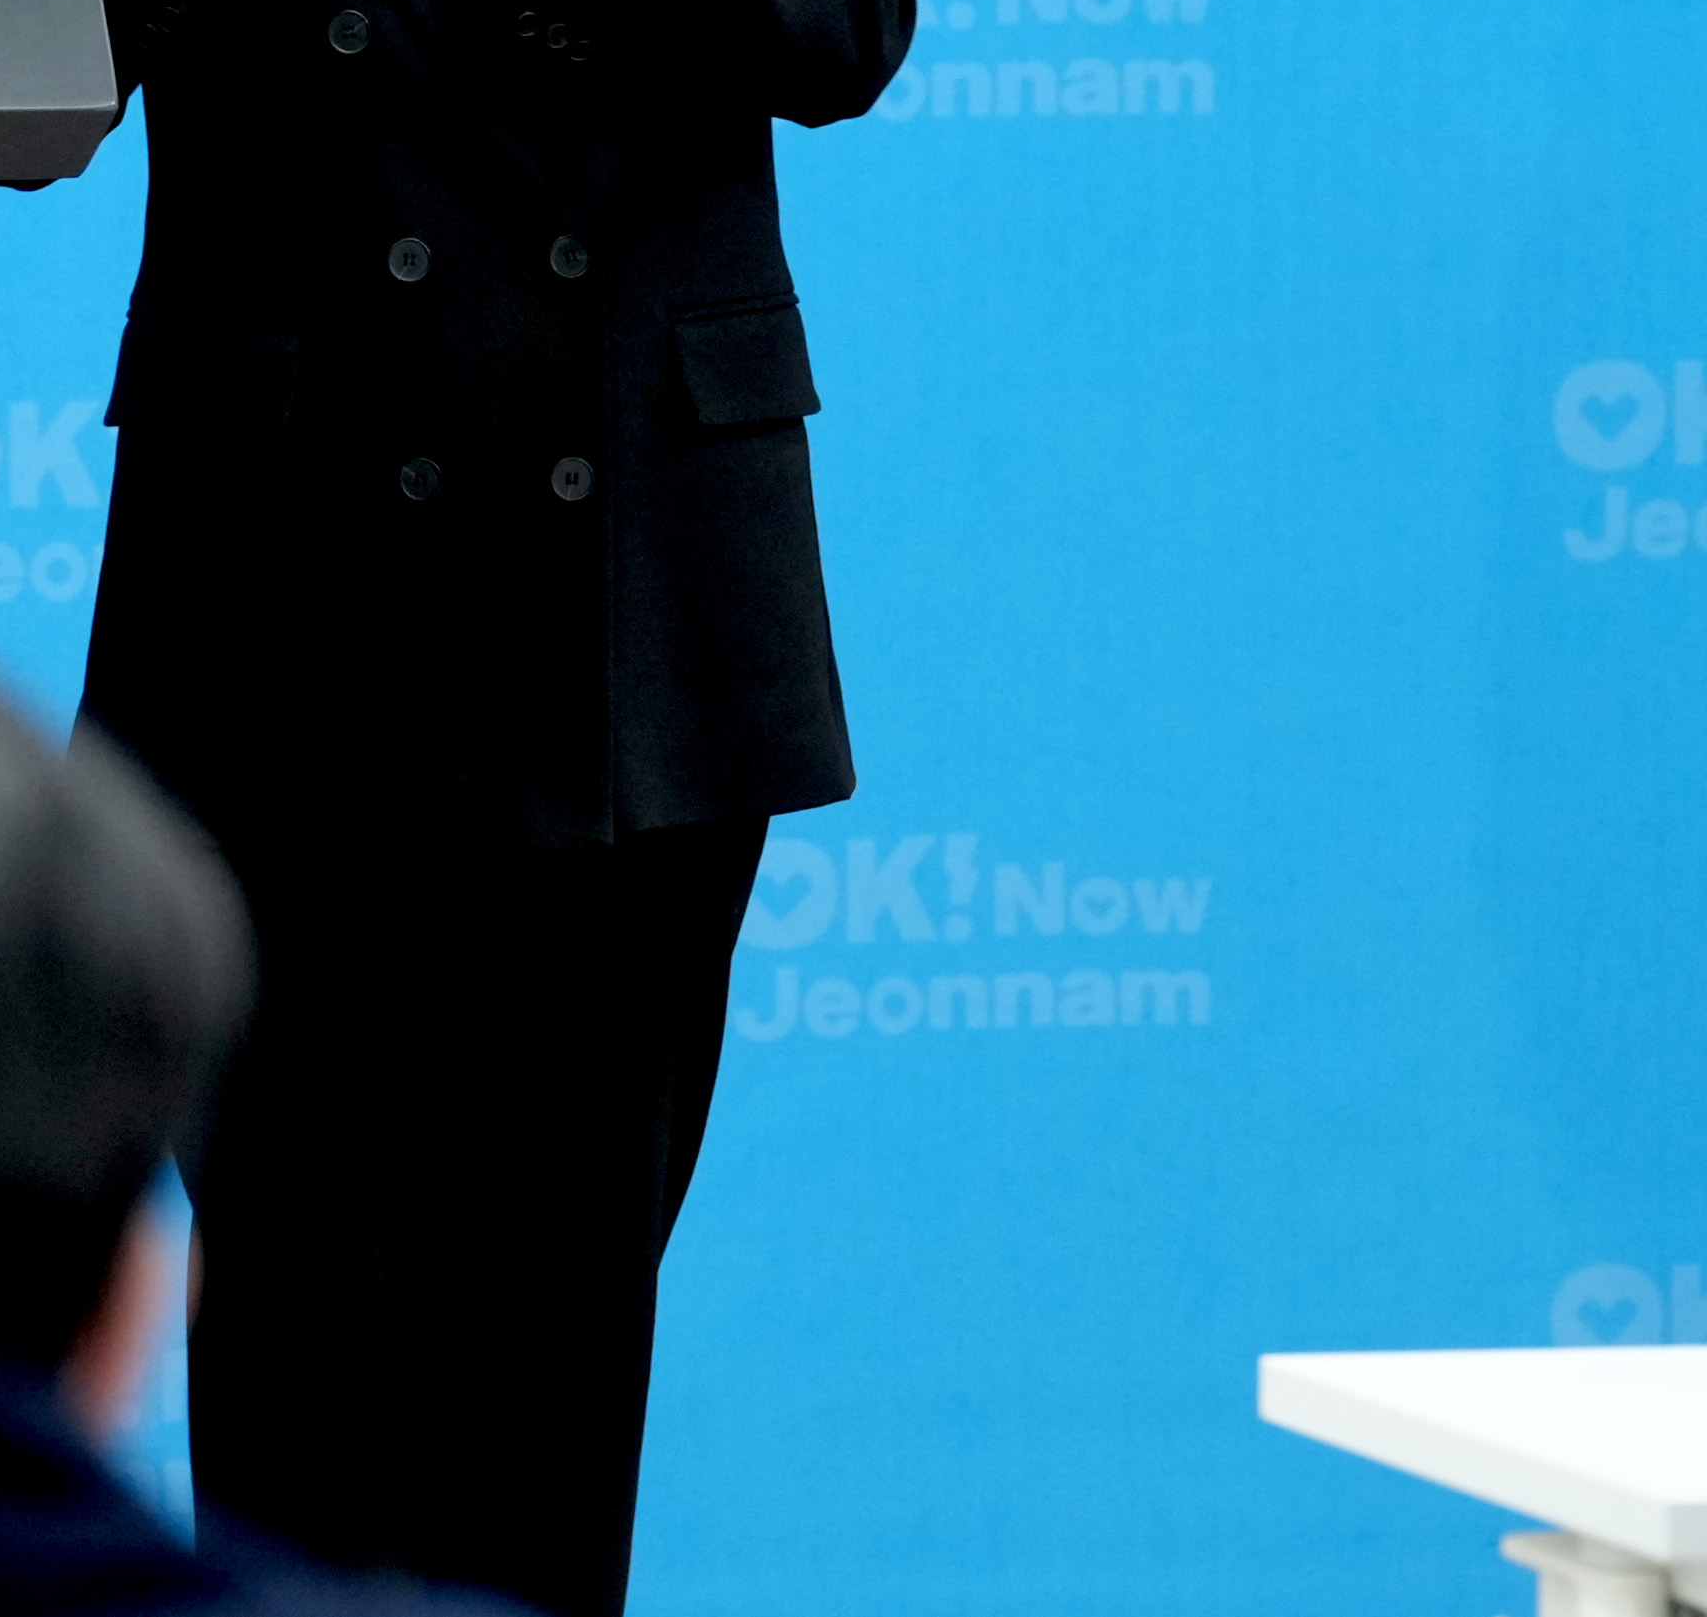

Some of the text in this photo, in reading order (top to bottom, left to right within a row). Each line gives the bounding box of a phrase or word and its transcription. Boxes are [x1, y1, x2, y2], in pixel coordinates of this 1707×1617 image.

[872, 57, 1216, 123] onnam
[1564, 484, 1707, 562] Je
[733, 964, 1213, 1044] Jeonnam
